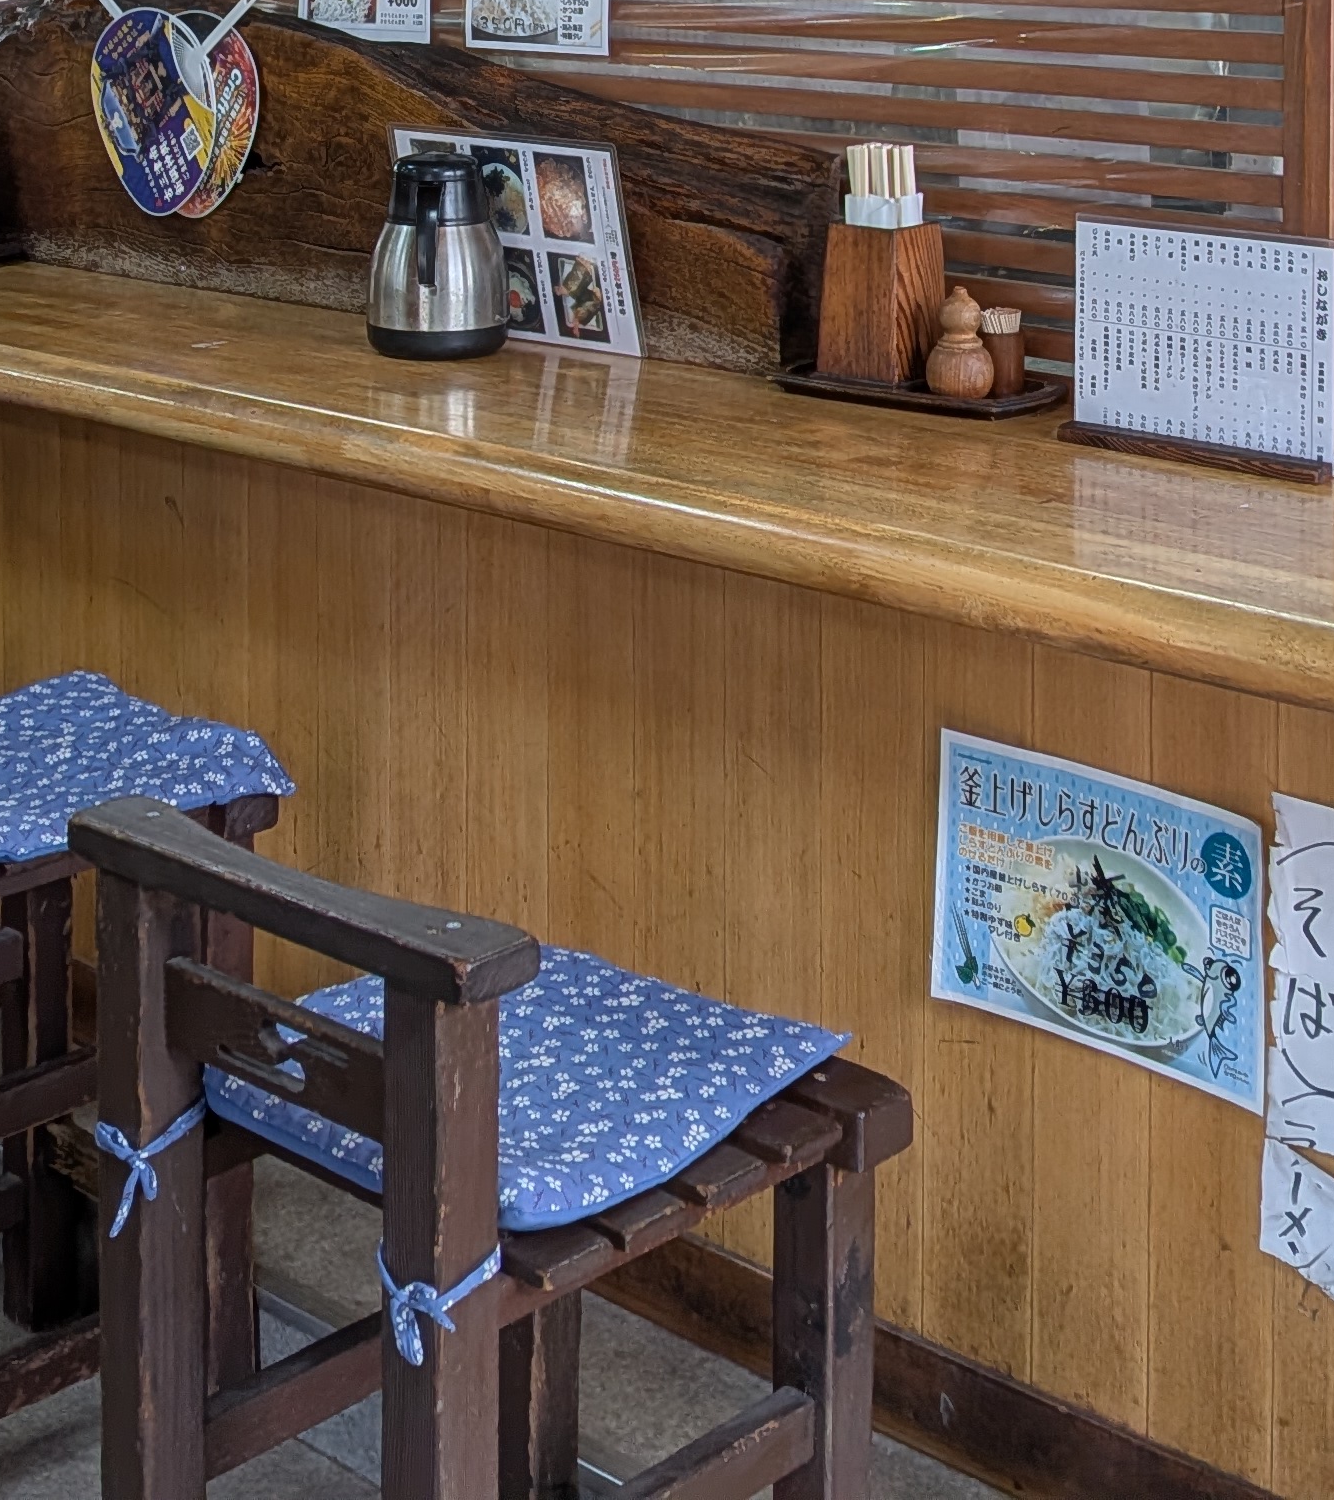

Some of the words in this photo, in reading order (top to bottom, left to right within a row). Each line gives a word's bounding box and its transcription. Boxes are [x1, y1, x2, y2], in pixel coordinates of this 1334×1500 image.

[1315, 268, 1329, 341] おしながき
[959, 766, 1244, 893] 釜上げしらすどんぶりの素
